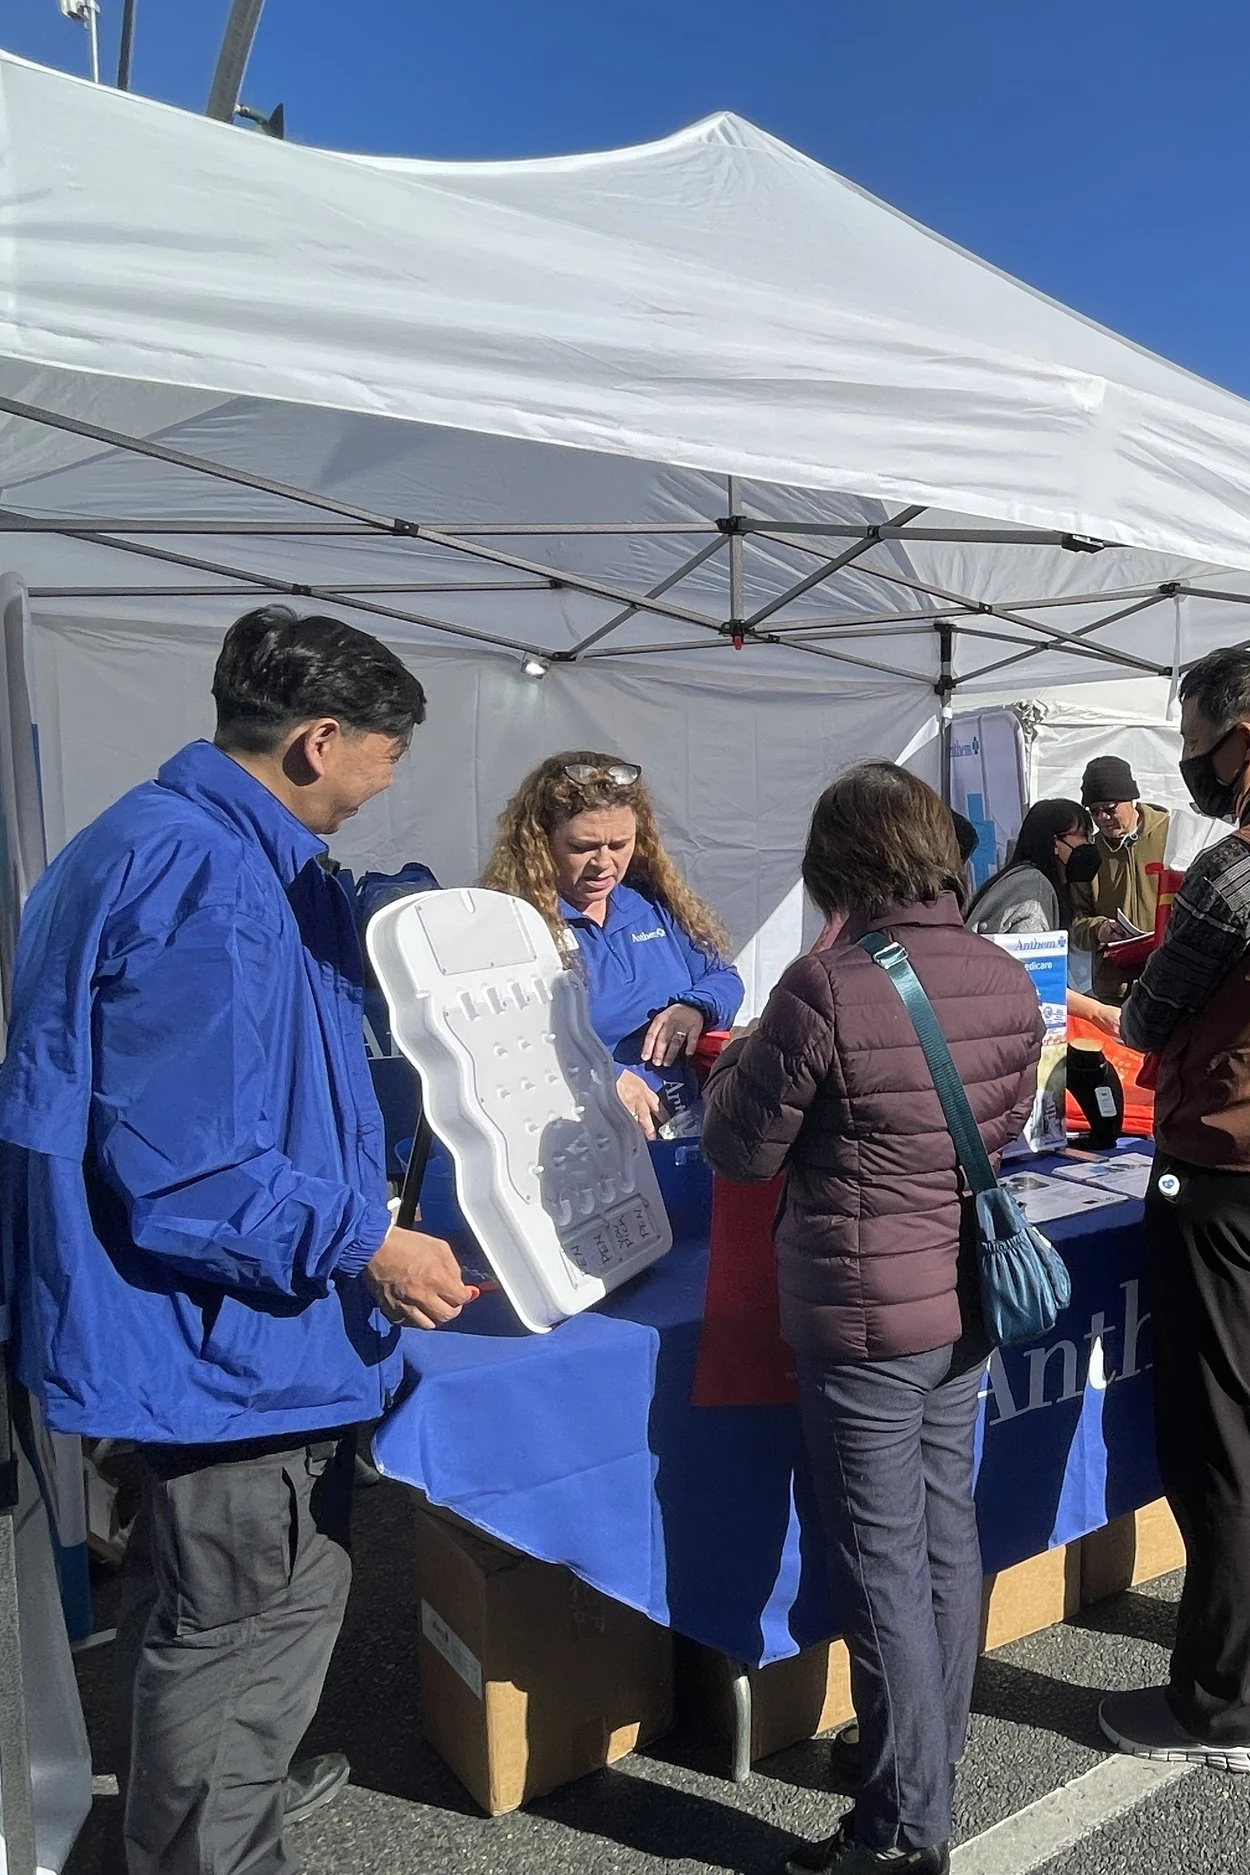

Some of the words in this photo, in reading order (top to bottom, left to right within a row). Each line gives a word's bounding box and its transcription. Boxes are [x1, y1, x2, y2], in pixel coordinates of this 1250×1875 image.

[1015, 937, 1056, 951] Anthem
[1024, 961, 1053, 970] edicare
[663, 1080, 686, 1111] Ant
[634, 1209, 650, 1238] PEN
[570, 1245, 590, 1275] EN
[593, 1233, 613, 1264] PEN
[977, 1279, 1153, 1426] Anth
